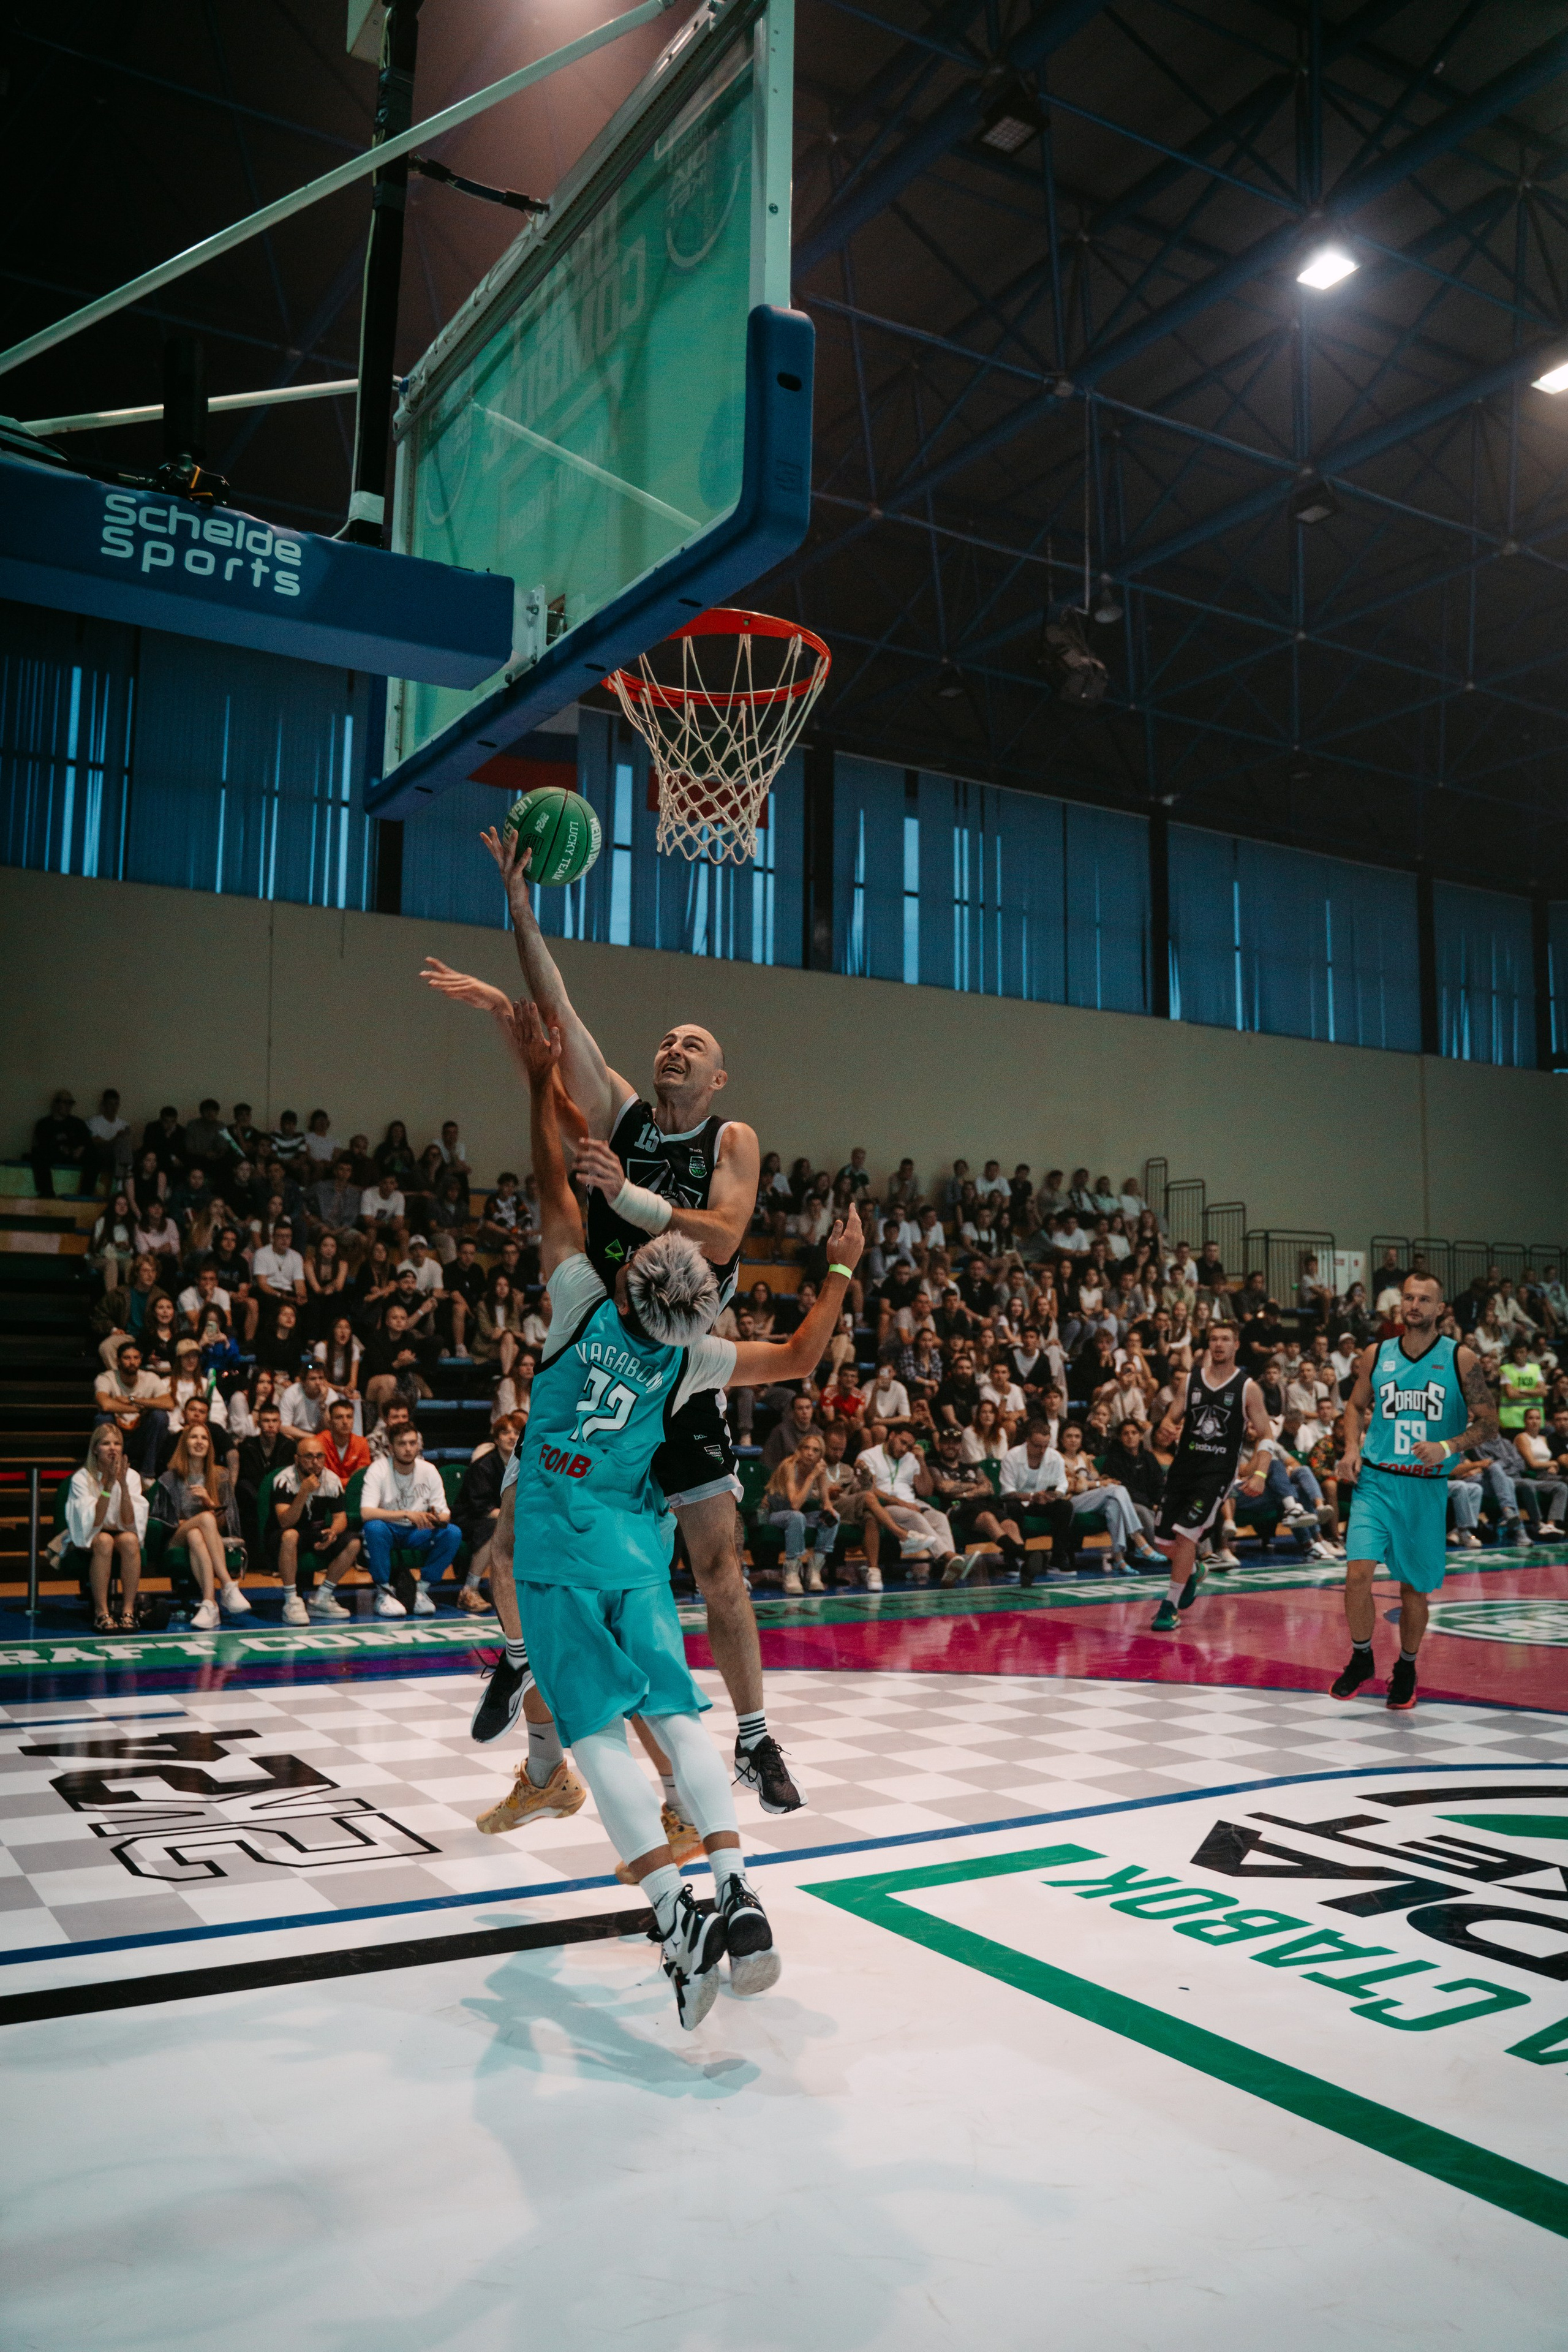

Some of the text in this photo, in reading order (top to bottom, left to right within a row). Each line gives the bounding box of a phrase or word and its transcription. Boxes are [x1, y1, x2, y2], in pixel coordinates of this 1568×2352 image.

[104, 494, 302, 567] Schelde
[100, 525, 301, 597] Sports
[508, 796, 533, 822] LIGA
[551, 821, 579, 881] LUCKY TEAM
[634, 1123, 660, 1153] 15
[1394, 1419, 1427, 1455] 69
[238, 1625, 505, 1652] COMB
